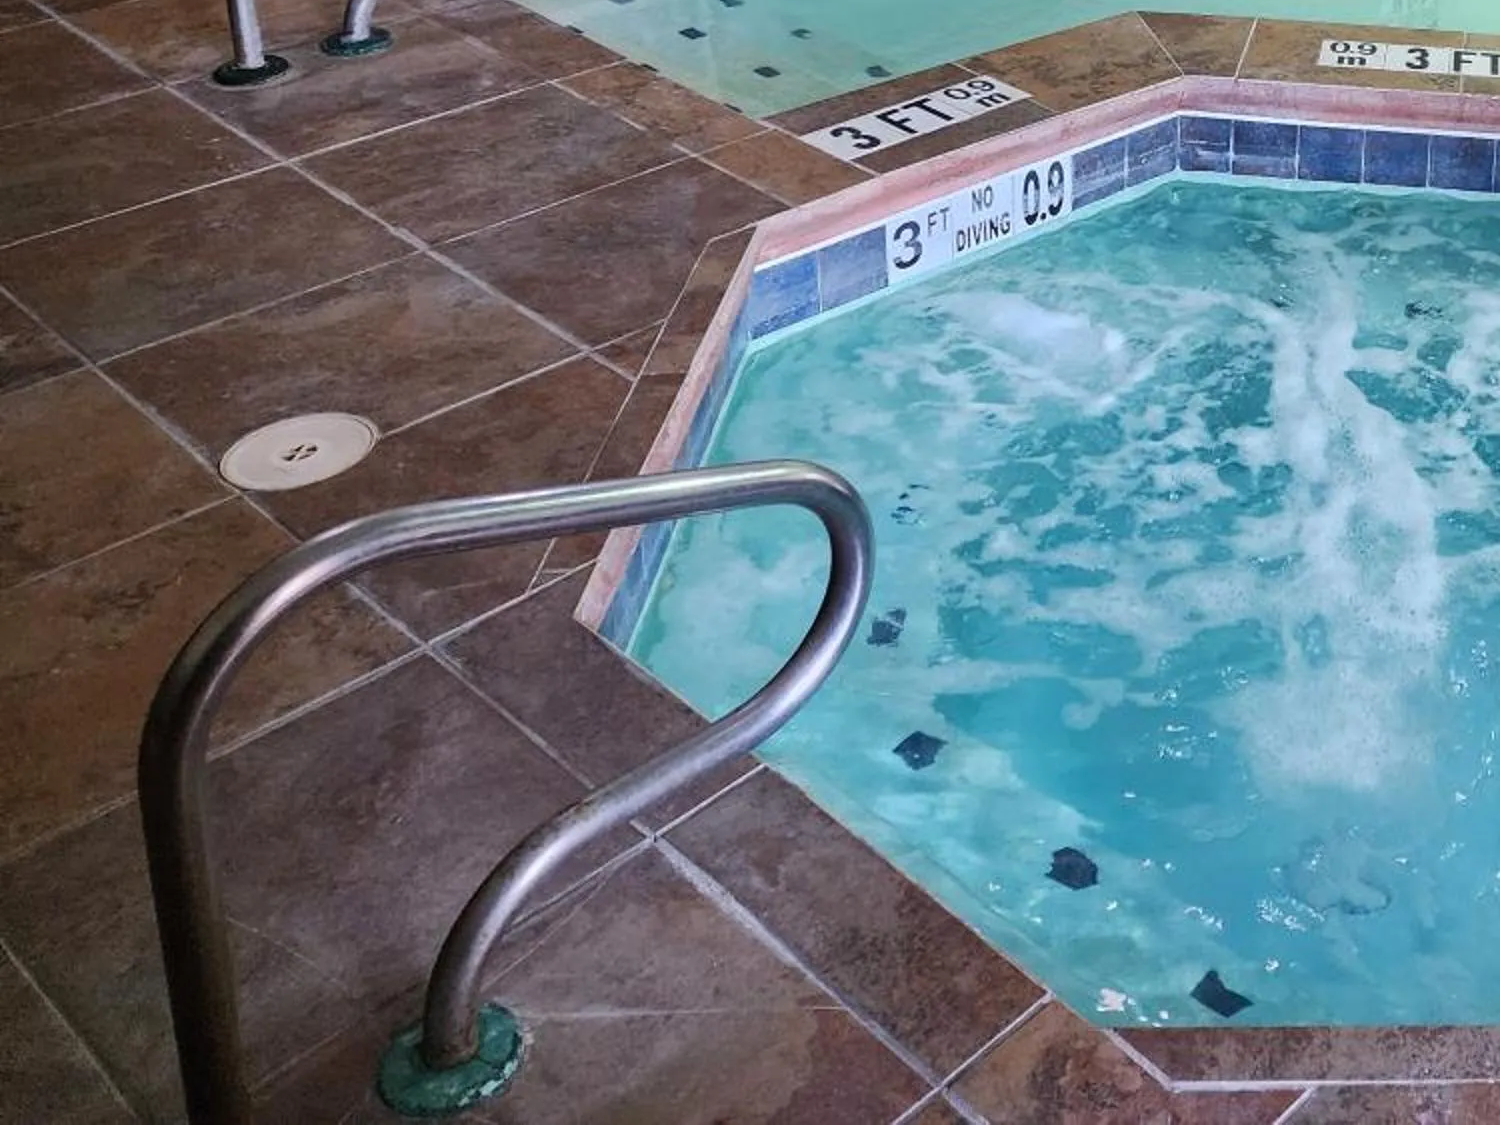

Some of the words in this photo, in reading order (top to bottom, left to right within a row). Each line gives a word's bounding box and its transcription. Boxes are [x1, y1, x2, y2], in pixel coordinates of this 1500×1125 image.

[1330, 41, 1378, 56] 0.9
[1405, 48, 1430, 69] 3
[829, 126, 882, 150] 3
[876, 98, 954, 135] FT
[971, 185, 994, 211] NO
[1022, 160, 1065, 226] 0.9
[893, 220, 923, 269] 3
[927, 206, 950, 237] FT
[956, 211, 1011, 252] DIVING
